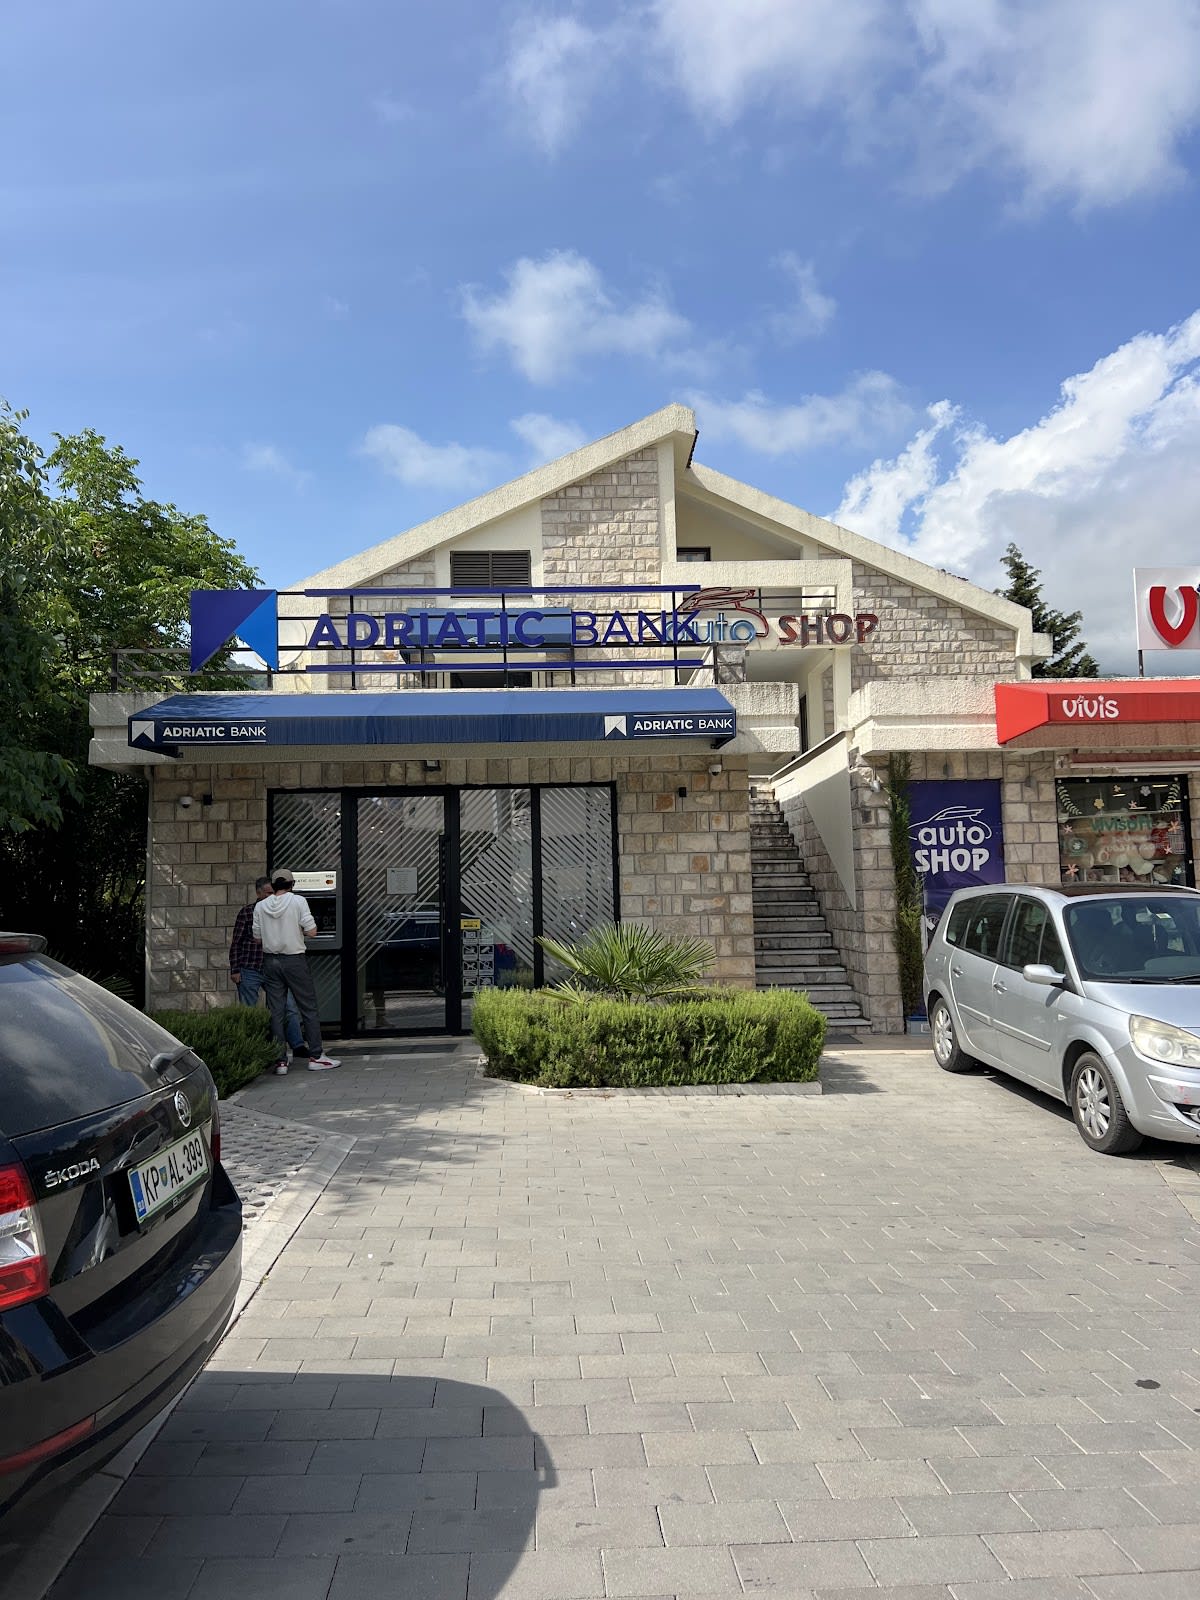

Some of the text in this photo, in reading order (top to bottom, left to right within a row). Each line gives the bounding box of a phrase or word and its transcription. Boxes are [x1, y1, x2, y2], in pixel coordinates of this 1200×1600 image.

[307, 609, 700, 649] ADRIATIC BANK
[778, 613, 879, 648] SHOP
[163, 726, 267, 738] ADRIATIC BANK
[633, 717, 733, 731] ADRIATIC BANK
[918, 820, 985, 846] auto
[914, 848, 990, 875] SHOP
[44, 1157, 101, 1189] ŠKODA
[142, 1166, 160, 1206] KP
